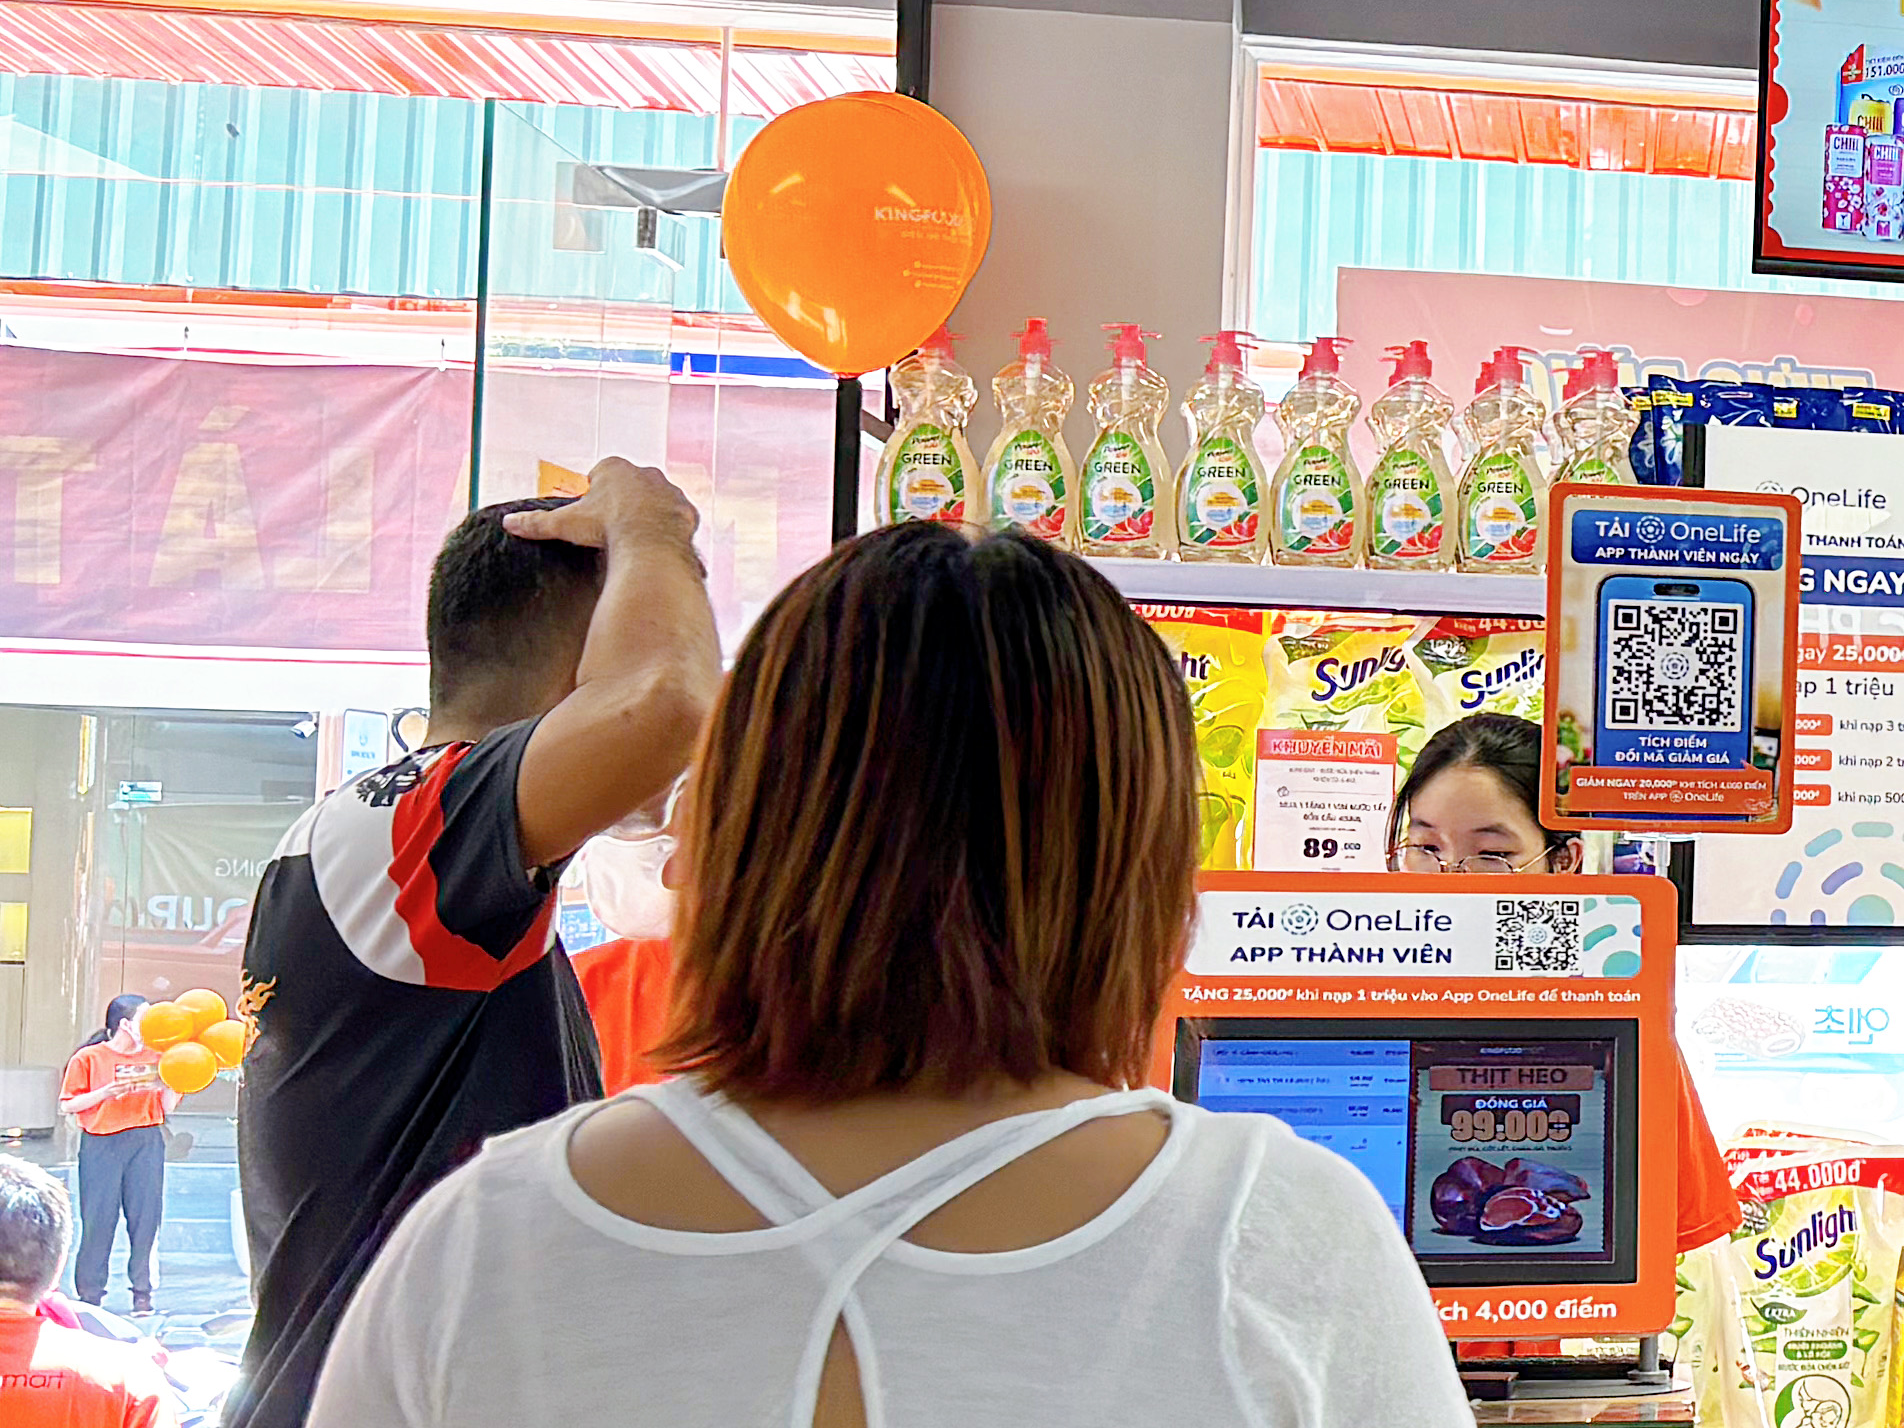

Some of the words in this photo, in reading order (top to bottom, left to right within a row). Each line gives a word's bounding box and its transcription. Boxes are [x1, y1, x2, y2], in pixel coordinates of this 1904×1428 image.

[902, 451, 953, 468] GREEN
[1004, 458, 1054, 474] GREEN
[1094, 461, 1142, 475] GREEN
[1791, 486, 1887, 510] OneLife
[1595, 516, 1630, 538] TẢI
[1670, 521, 1761, 545] OneLife
[1807, 534, 1862, 548] THANH
[1595, 547, 1624, 559] APP
[1628, 546, 1679, 561] THÀNH
[1684, 547, 1716, 563] VIÊN
[1719, 551, 1760, 564] NGAY
[1826, 678, 1837, 694] 1
[1846, 679, 1894, 700] triệu
[1638, 735, 1670, 748] TÍCH
[1674, 735, 1707, 749] ĐIỂM
[1615, 748, 1640, 762] ĐỔI
[1643, 749, 1665, 763] MÃ
[1668, 749, 1702, 763] GIẢM
[1706, 749, 1730, 764] GIÁ
[1837, 791, 1855, 803] khi
[1858, 794, 1881, 805] nạp
[1303, 837, 1339, 858] 89
[1233, 905, 1274, 929] TẢI
[1326, 908, 1452, 933] OneLife
[1230, 946, 1283, 963] APP
[1293, 941, 1384, 964] THÀNH
[1393, 942, 1452, 965] VIÊN
[1182, 987, 1229, 1003] TẶNG
[1296, 987, 1319, 1001] khi
[1322, 991, 1353, 1005] nạp
[1358, 991, 1367, 1001] 1
[1371, 989, 1407, 1005] triệu
[1441, 990, 1474, 1005] App
[1477, 991, 1535, 1002] OneLife
[1561, 989, 1604, 1002] thanh
[1608, 989, 1640, 1002] toán
[1457, 1068, 1511, 1087] THỊT
[1518, 1068, 1567, 1084] HEO
[1754, 1202, 1858, 1280] Sunligh
[1476, 1300, 1548, 1324] 4,000
[1554, 1297, 1617, 1319] điểm
